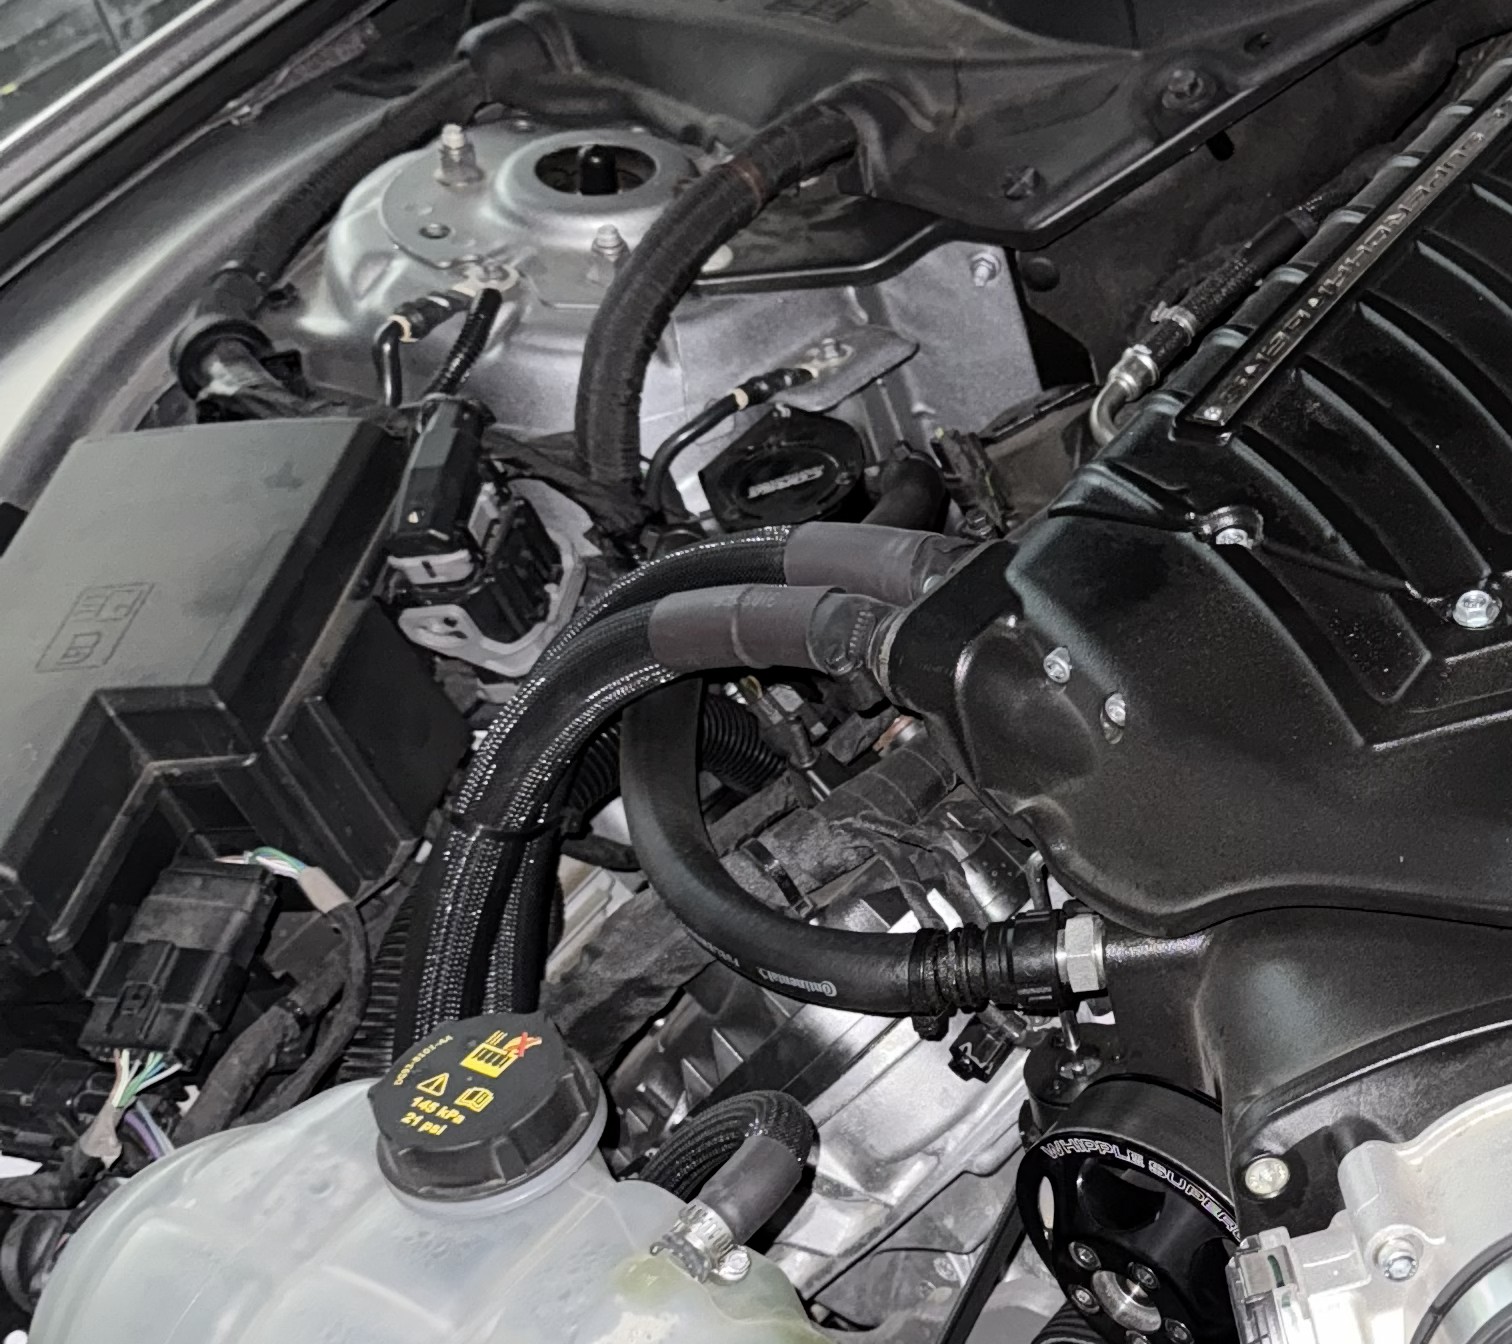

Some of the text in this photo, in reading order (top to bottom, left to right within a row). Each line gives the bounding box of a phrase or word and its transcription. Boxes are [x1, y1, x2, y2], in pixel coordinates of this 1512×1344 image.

[765, 969, 837, 997] Continental
[401, 1113, 447, 1135] 21 psi
[412, 1097, 465, 1124] 145 kPa
[1041, 1138, 1145, 1168] WHIPPLE
